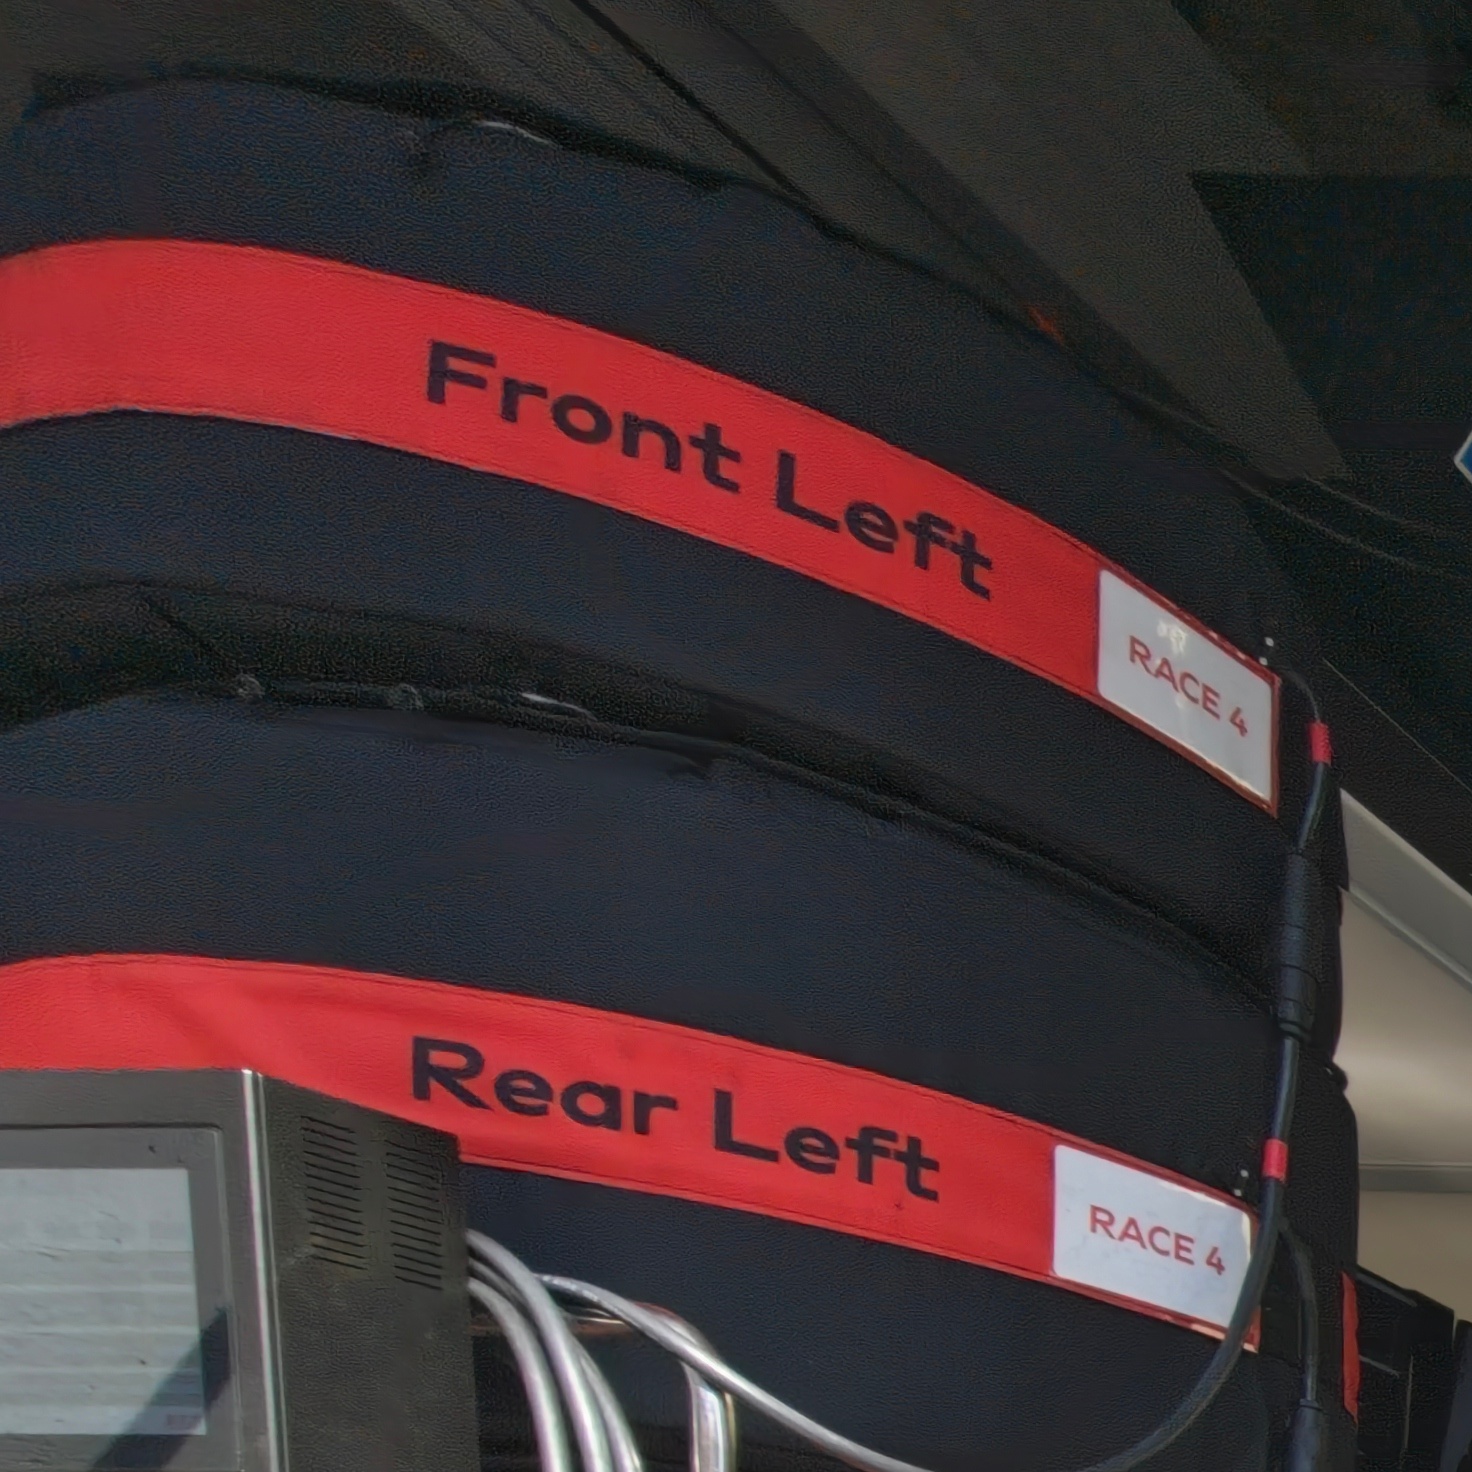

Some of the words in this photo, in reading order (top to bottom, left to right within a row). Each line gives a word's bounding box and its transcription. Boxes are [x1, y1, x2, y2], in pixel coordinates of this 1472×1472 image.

[424, 337, 742, 496] Front
[776, 450, 994, 602] Left
[1127, 635, 1222, 717] RACE
[1230, 705, 1250, 739] 4
[410, 1035, 677, 1137] Rear
[712, 1088, 941, 1204] Left
[1089, 1203, 1196, 1267] RACE
[1205, 1246, 1227, 1278] 4
